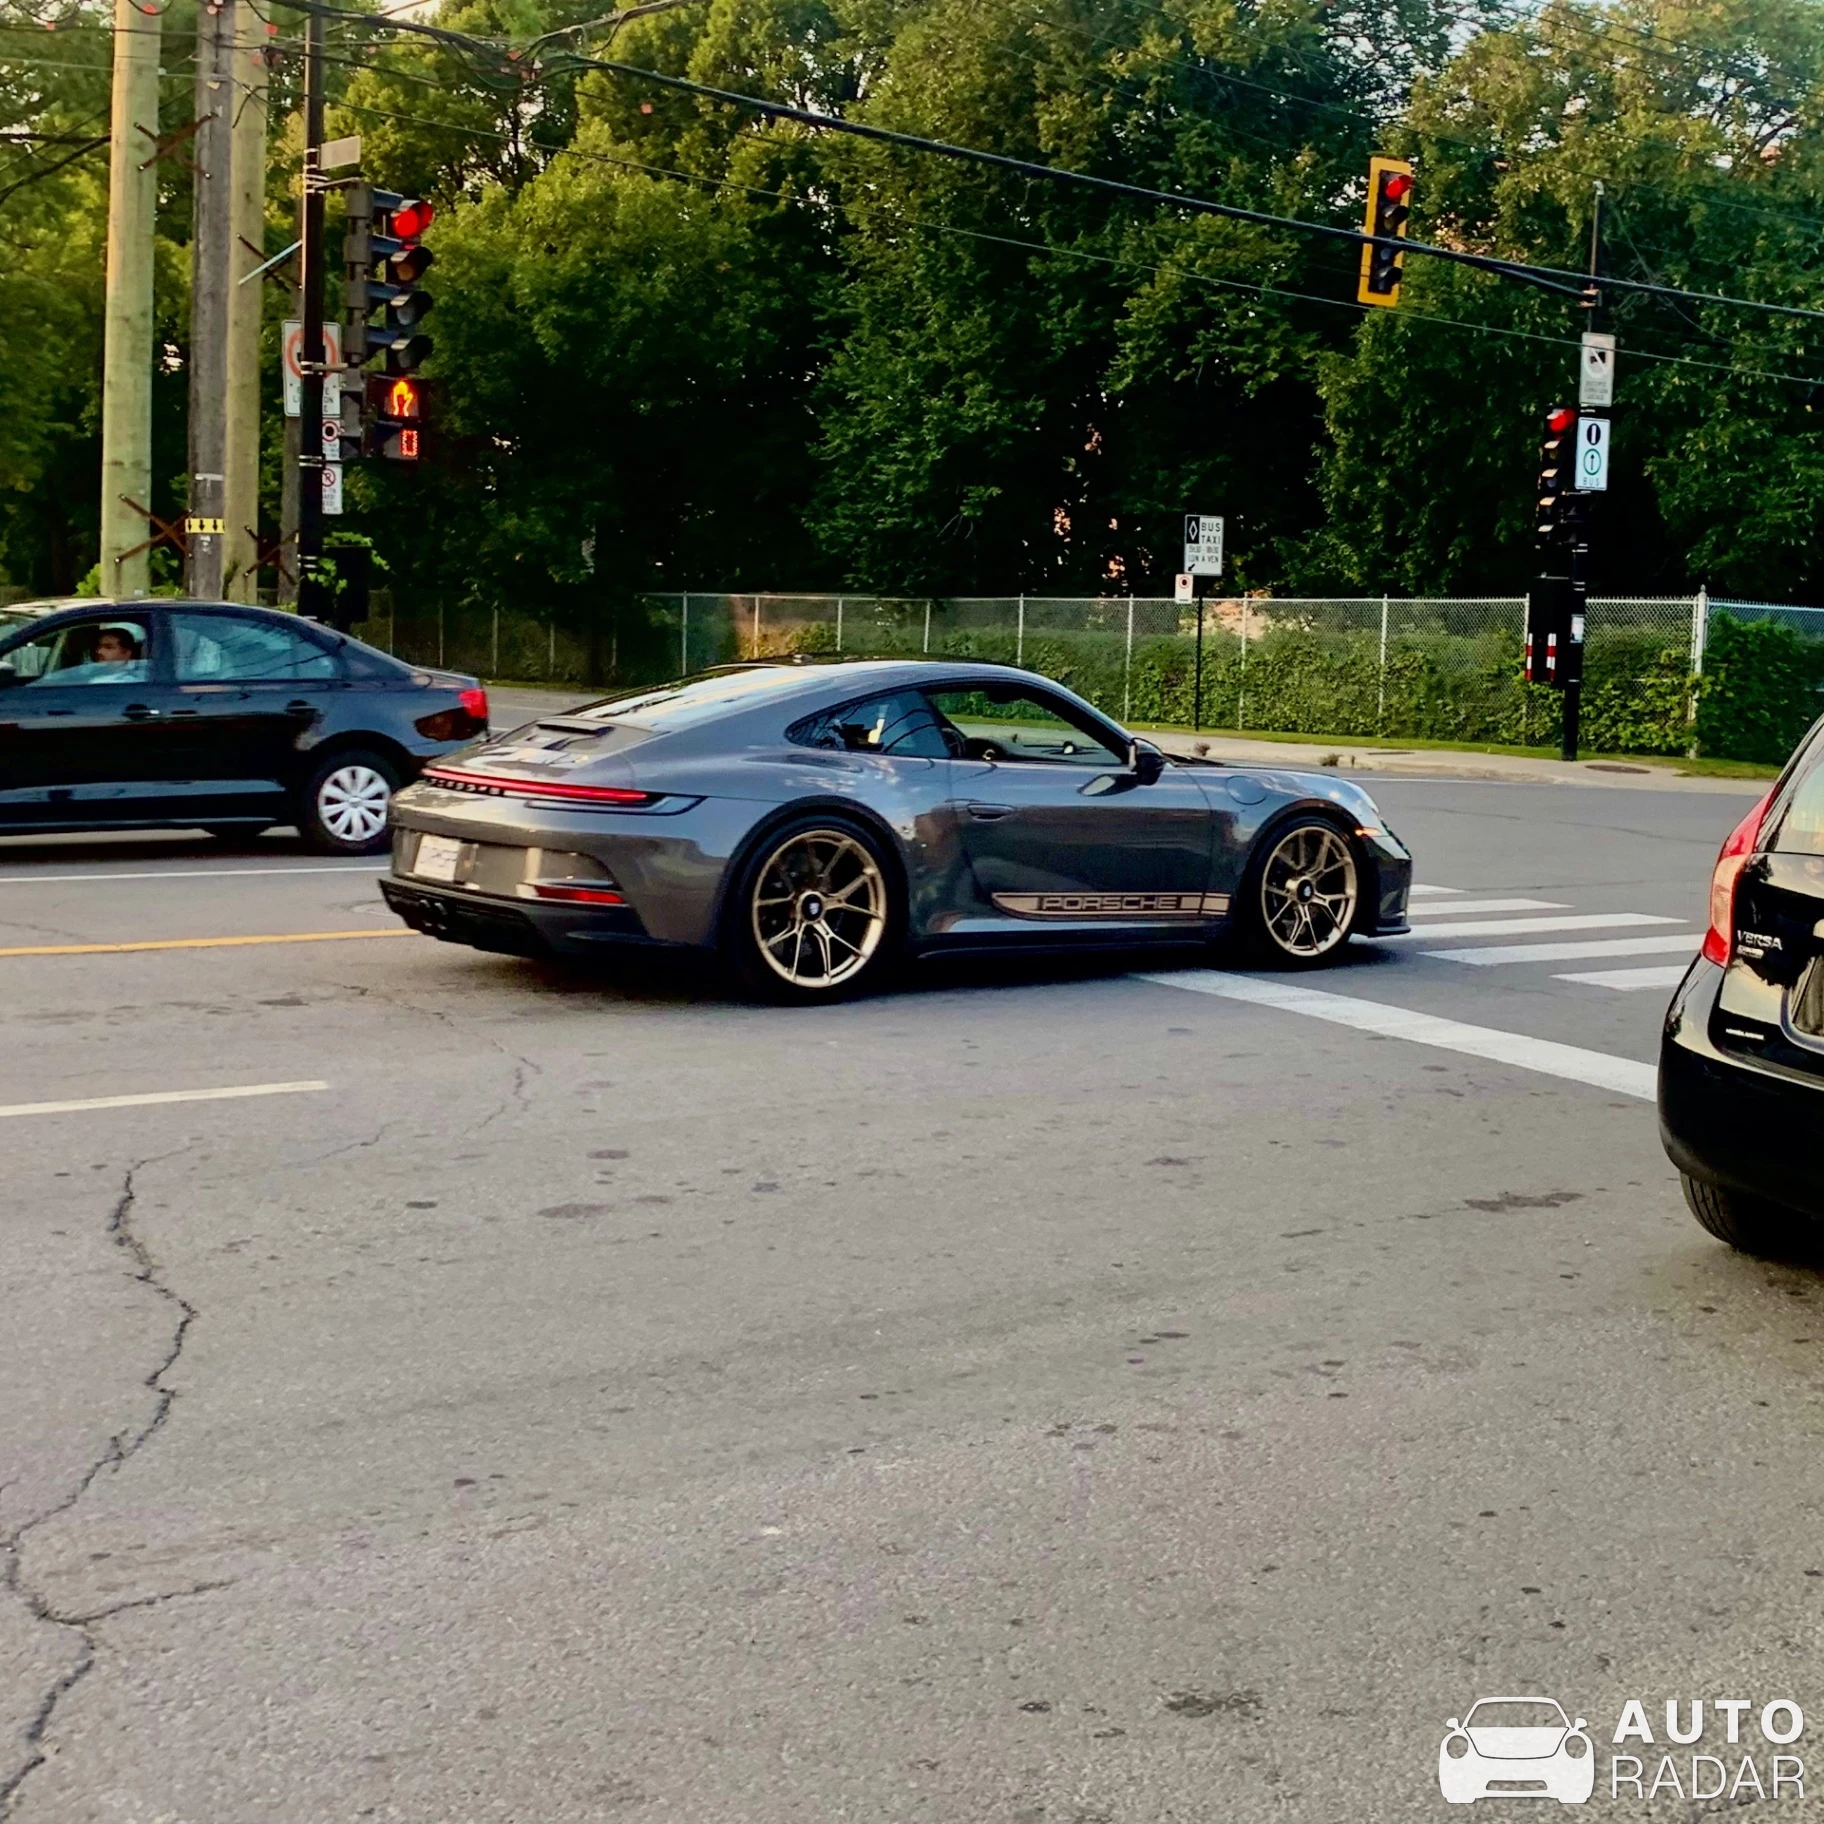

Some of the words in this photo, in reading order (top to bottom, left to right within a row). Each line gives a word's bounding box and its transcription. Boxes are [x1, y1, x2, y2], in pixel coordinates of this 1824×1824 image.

[402, 429, 418, 456] 0
[1583, 476, 1600, 487] BUS
[1201, 522, 1221, 532] BUS
[1201, 535, 1221, 545] TAXI
[1041, 896, 1178, 910] PORSCHE
[1737, 929, 1783, 951] VERSA
